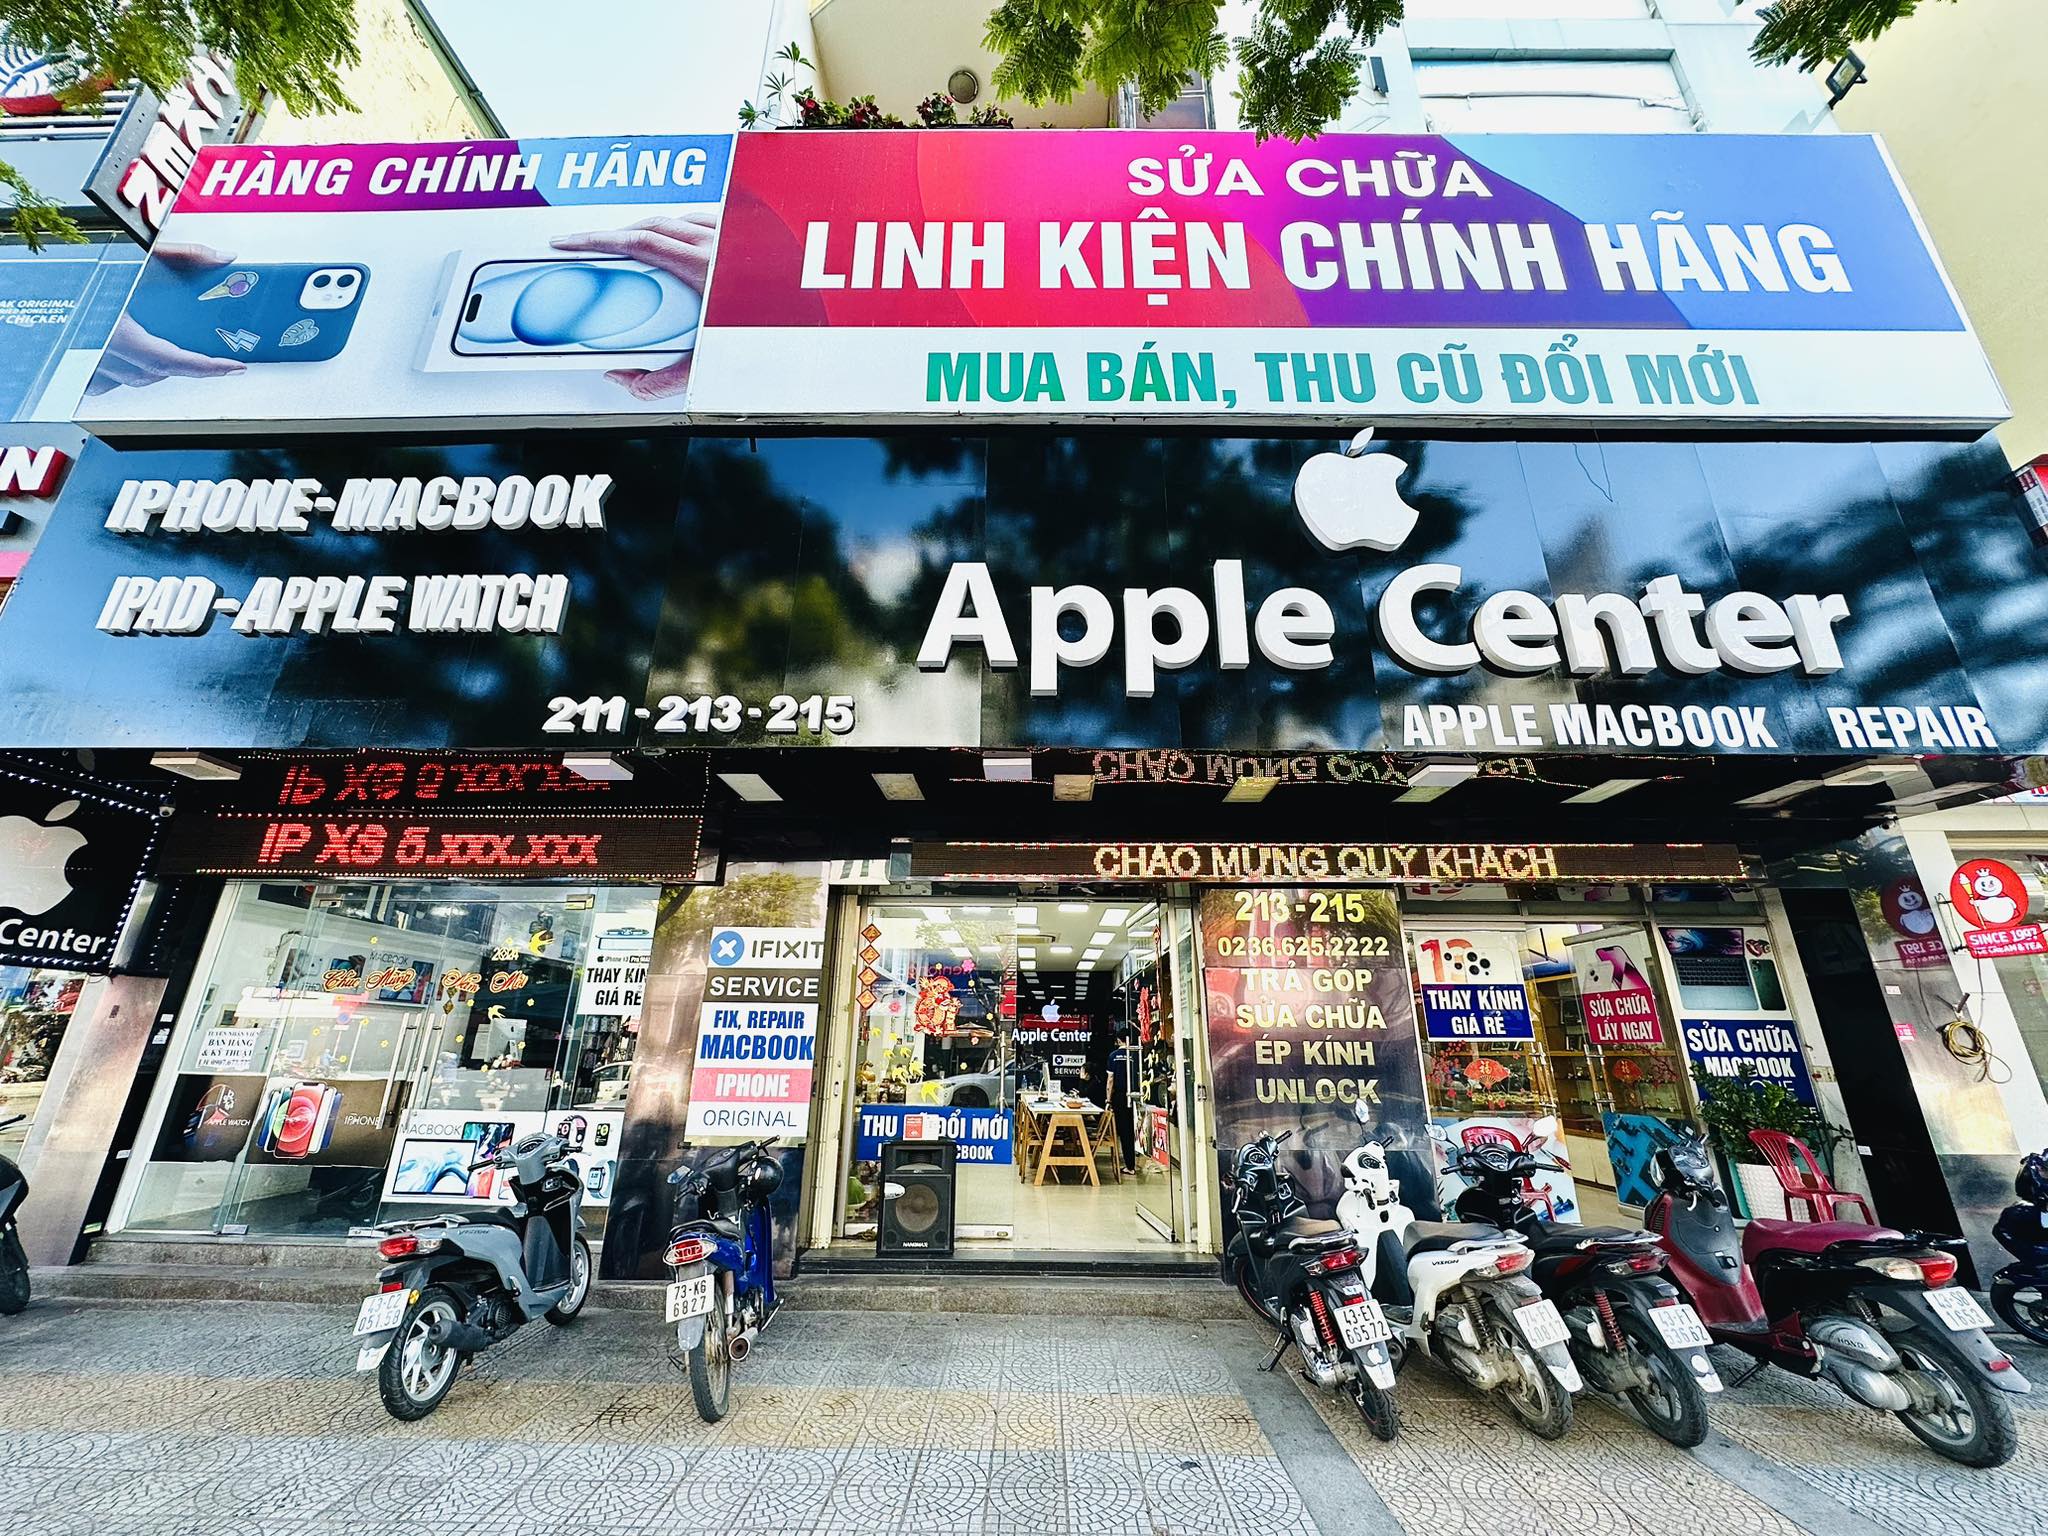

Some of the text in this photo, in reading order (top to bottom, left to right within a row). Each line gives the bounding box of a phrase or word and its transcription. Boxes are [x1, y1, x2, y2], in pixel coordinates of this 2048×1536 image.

[201, 143, 707, 195] HÀNG CHÍNH HÃNG
[1127, 144, 1494, 198] SỬA CHỮA
[801, 207, 1853, 306] LINH KIỆN CHÍNH HÃNG
[17, 299, 76, 308] ORIGINAL
[6, 314, 68, 324] CHICKEN
[926, 333, 1760, 409] MUA BÁN, THU CŨ ĐỔI MỚI
[407, 573, 571, 635] WATCH
[916, 558, 1851, 698] Apple Center
[541, 696, 628, 734] 211
[653, 695, 742, 734] 213
[765, 695, 857, 734] 215
[1402, 703, 1999, 749] APPLE MACBOOK REPAIR
[257, 823, 312, 863] IP
[1234, 891, 1290, 924] 213
[1308, 892, 1365, 923] 215
[0, 918, 107, 954] Center
[1217, 935, 1390, 958] 0236.625.2222
[1969, 931, 2009, 945] SINCE
[751, 940, 825, 961] IFIXIT
[587, 967, 621, 983] THAY
[709, 976, 820, 997] SERVICE
[1241, 960, 1373, 993] TRẢ GÓP
[595, 986, 619, 1006] GIÁ
[1427, 986, 1525, 1011] THAY KÍNH
[1589, 992, 1651, 1018] SỬA CHỮA
[713, 1010, 805, 1030] FIX, REPAIR
[1236, 997, 1388, 1030] SỬA CHỮA
[1451, 1010, 1507, 1035] GIÁ RẺ
[1011, 1028, 1092, 1044] Apple Center
[1597, 1016, 1654, 1041] LẤY NGAY
[1687, 1021, 1798, 1053] SỬA CHỮA
[699, 1034, 815, 1060] MACBOOK
[1254, 1033, 1376, 1066] ÉP KÍNH
[1054, 1067, 1082, 1076] SERVIC
[714, 1073, 791, 1098] IPHONE
[1255, 1078, 1382, 1104] UNLOCK
[344, 1115, 381, 1126] IPHONE
[401, 1122, 462, 1137] MACBOOK
[702, 1109, 798, 1128] ORIGINAL
[862, 1114, 898, 1137] THU
[971, 1111, 1009, 1140] MỚI
[674, 1280, 707, 1299] 73-K6
[673, 1296, 707, 1318] 6827
[1343, 1305, 1375, 1325] 43-E1
